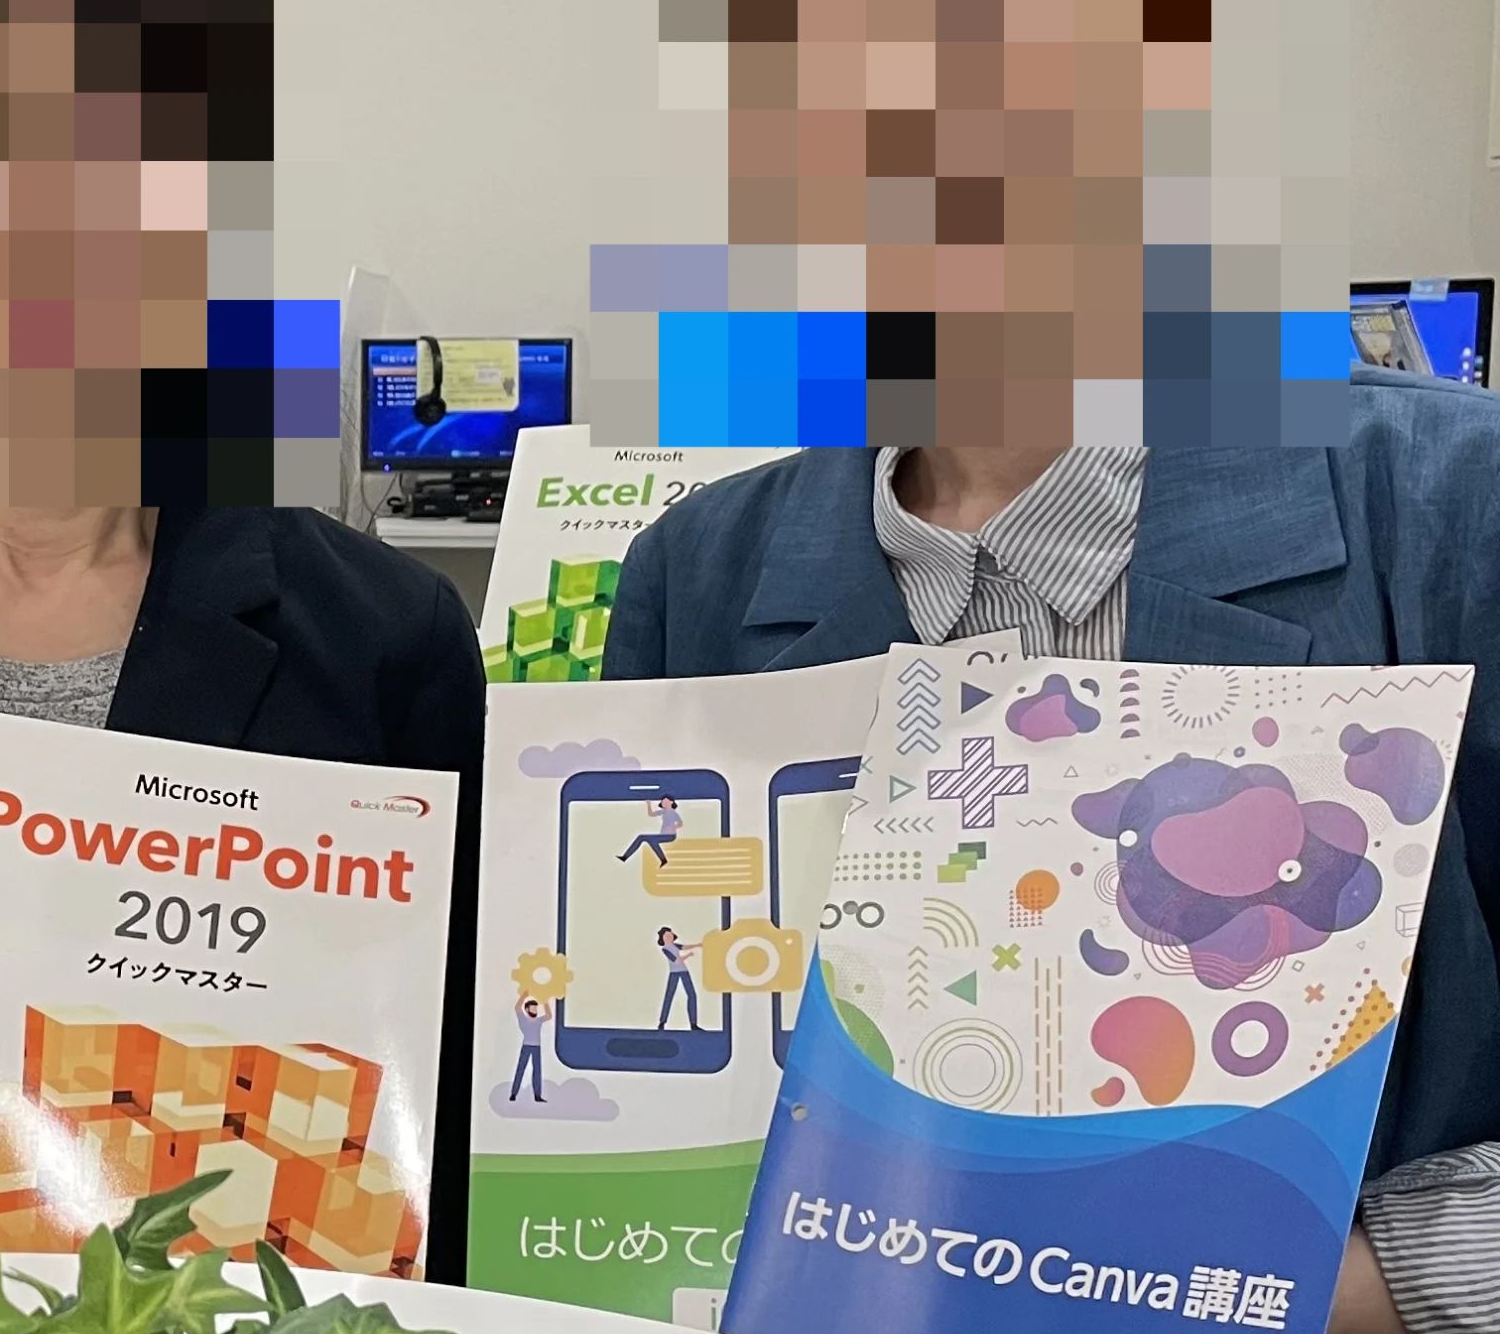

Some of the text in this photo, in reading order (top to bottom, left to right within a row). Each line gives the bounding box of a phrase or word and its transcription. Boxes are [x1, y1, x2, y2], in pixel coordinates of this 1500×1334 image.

[614, 450, 684, 463] Microsoft
[536, 473, 655, 508] Excel
[134, 773, 260, 811] Microsoft
[113, 890, 267, 955] 2019
[86, 952, 268, 995] クイックマスター
